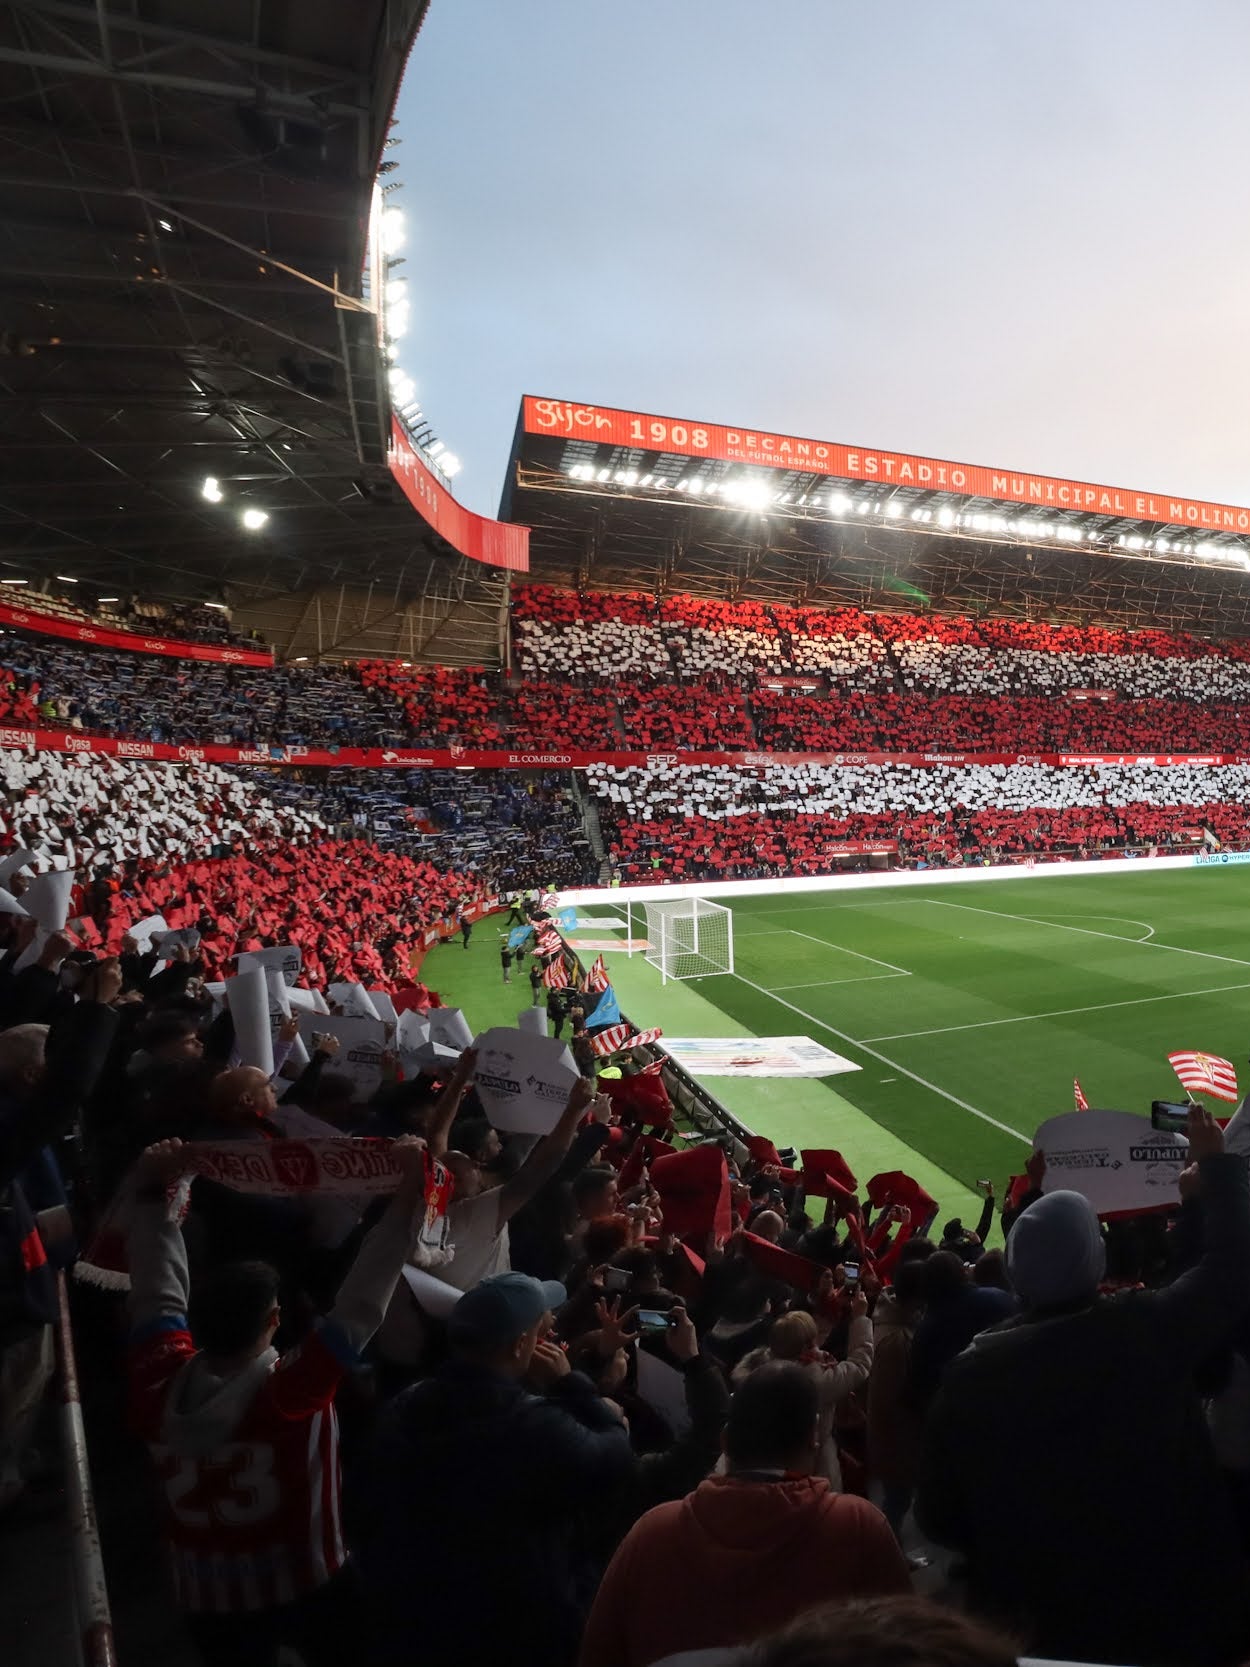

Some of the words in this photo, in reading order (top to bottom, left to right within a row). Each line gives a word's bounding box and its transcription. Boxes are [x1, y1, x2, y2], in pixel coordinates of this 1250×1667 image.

[630, 419, 709, 449] 1908
[726, 431, 830, 459] DECANO
[727, 448, 746, 459] DEL
[748, 449, 785, 465] FÚTBOL
[787, 456, 830, 471] ESPAÑOL
[846, 453, 967, 487] ESTADIO
[991, 475, 1125, 511] MUNICIPAL
[1135, 497, 1159, 516] EL
[0, 729, 36, 746] ISSAN
[65, 734, 91, 751] Cyasa
[117, 742, 154, 757] NISSAN
[238, 750, 292, 763] NISSN
[509, 755, 521, 763] EL
[521, 755, 572, 764] COMERCIO
[646, 755, 678, 764] SER
[846, 755, 868, 764] COPE
[146, 1441, 281, 1528] 23
